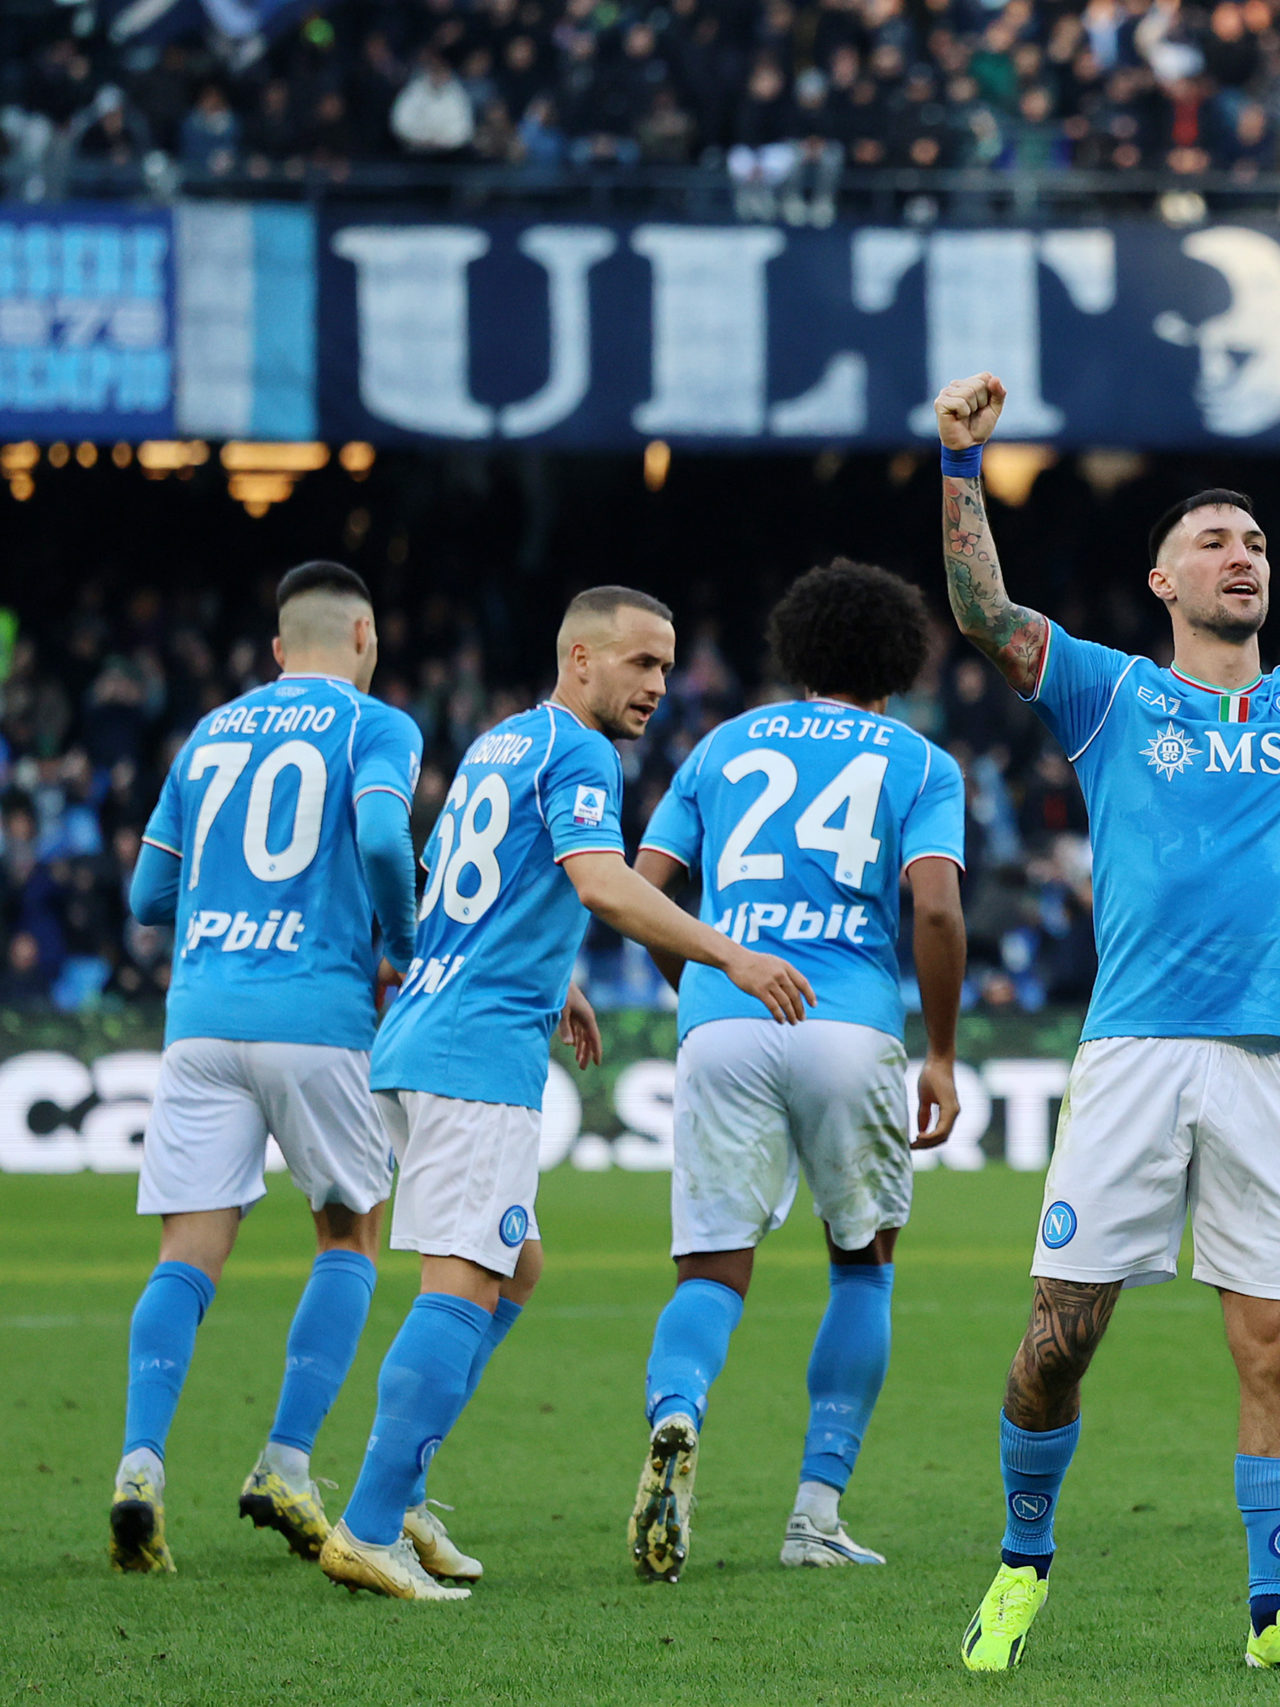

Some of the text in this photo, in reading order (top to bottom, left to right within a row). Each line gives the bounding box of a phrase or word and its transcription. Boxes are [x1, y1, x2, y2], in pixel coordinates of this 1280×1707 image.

[1136, 685, 1182, 716] EA7
[208, 705, 336, 736] GAETANO
[748, 715, 894, 746] CAJUSTE
[187, 739, 328, 892] 70
[717, 748, 889, 892] 24
